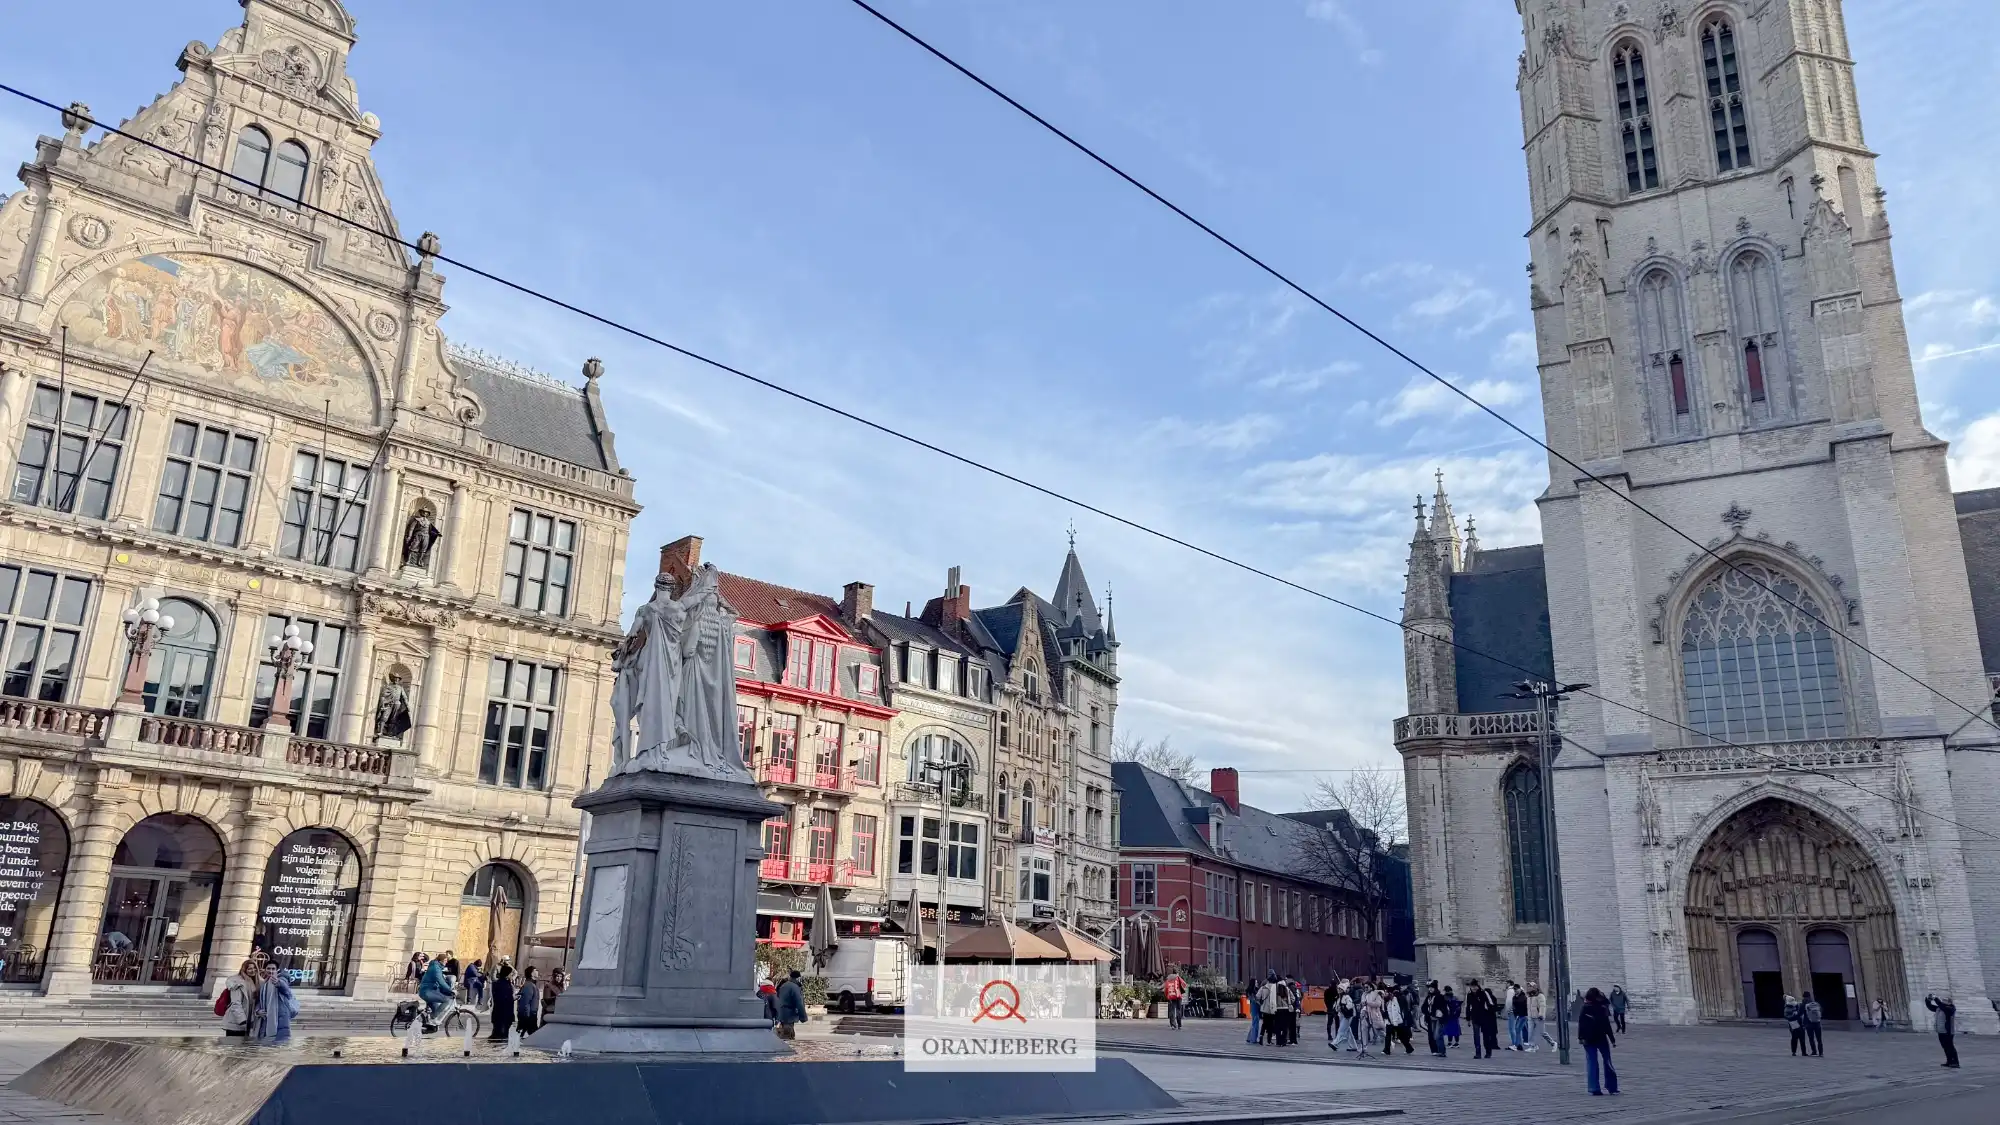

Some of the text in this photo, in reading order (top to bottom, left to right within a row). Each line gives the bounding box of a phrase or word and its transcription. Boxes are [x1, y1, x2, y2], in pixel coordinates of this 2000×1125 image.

[12, 821, 40, 834] 1948,
[5, 843, 31, 855] been
[292, 844, 338, 856] Sinds 1948
[7, 856, 40, 867] under
[281, 854, 343, 867] zijn alle landen
[0, 867, 45, 878] onal law
[295, 866, 328, 877] volgens
[31, 881, 44, 890] or
[270, 884, 346, 897] recht verplicht om
[0, 890, 38, 903] pected
[275, 896, 339, 906] een vermeende
[265, 905, 305, 915] genocide
[893, 905, 908, 914] Duve
[920, 907, 961, 921] BRGE
[262, 915, 311, 926] voorkomen
[312, 917, 329, 926] dan
[279, 927, 325, 938] te stoppen.
[273, 945, 323, 958] Ook België.
